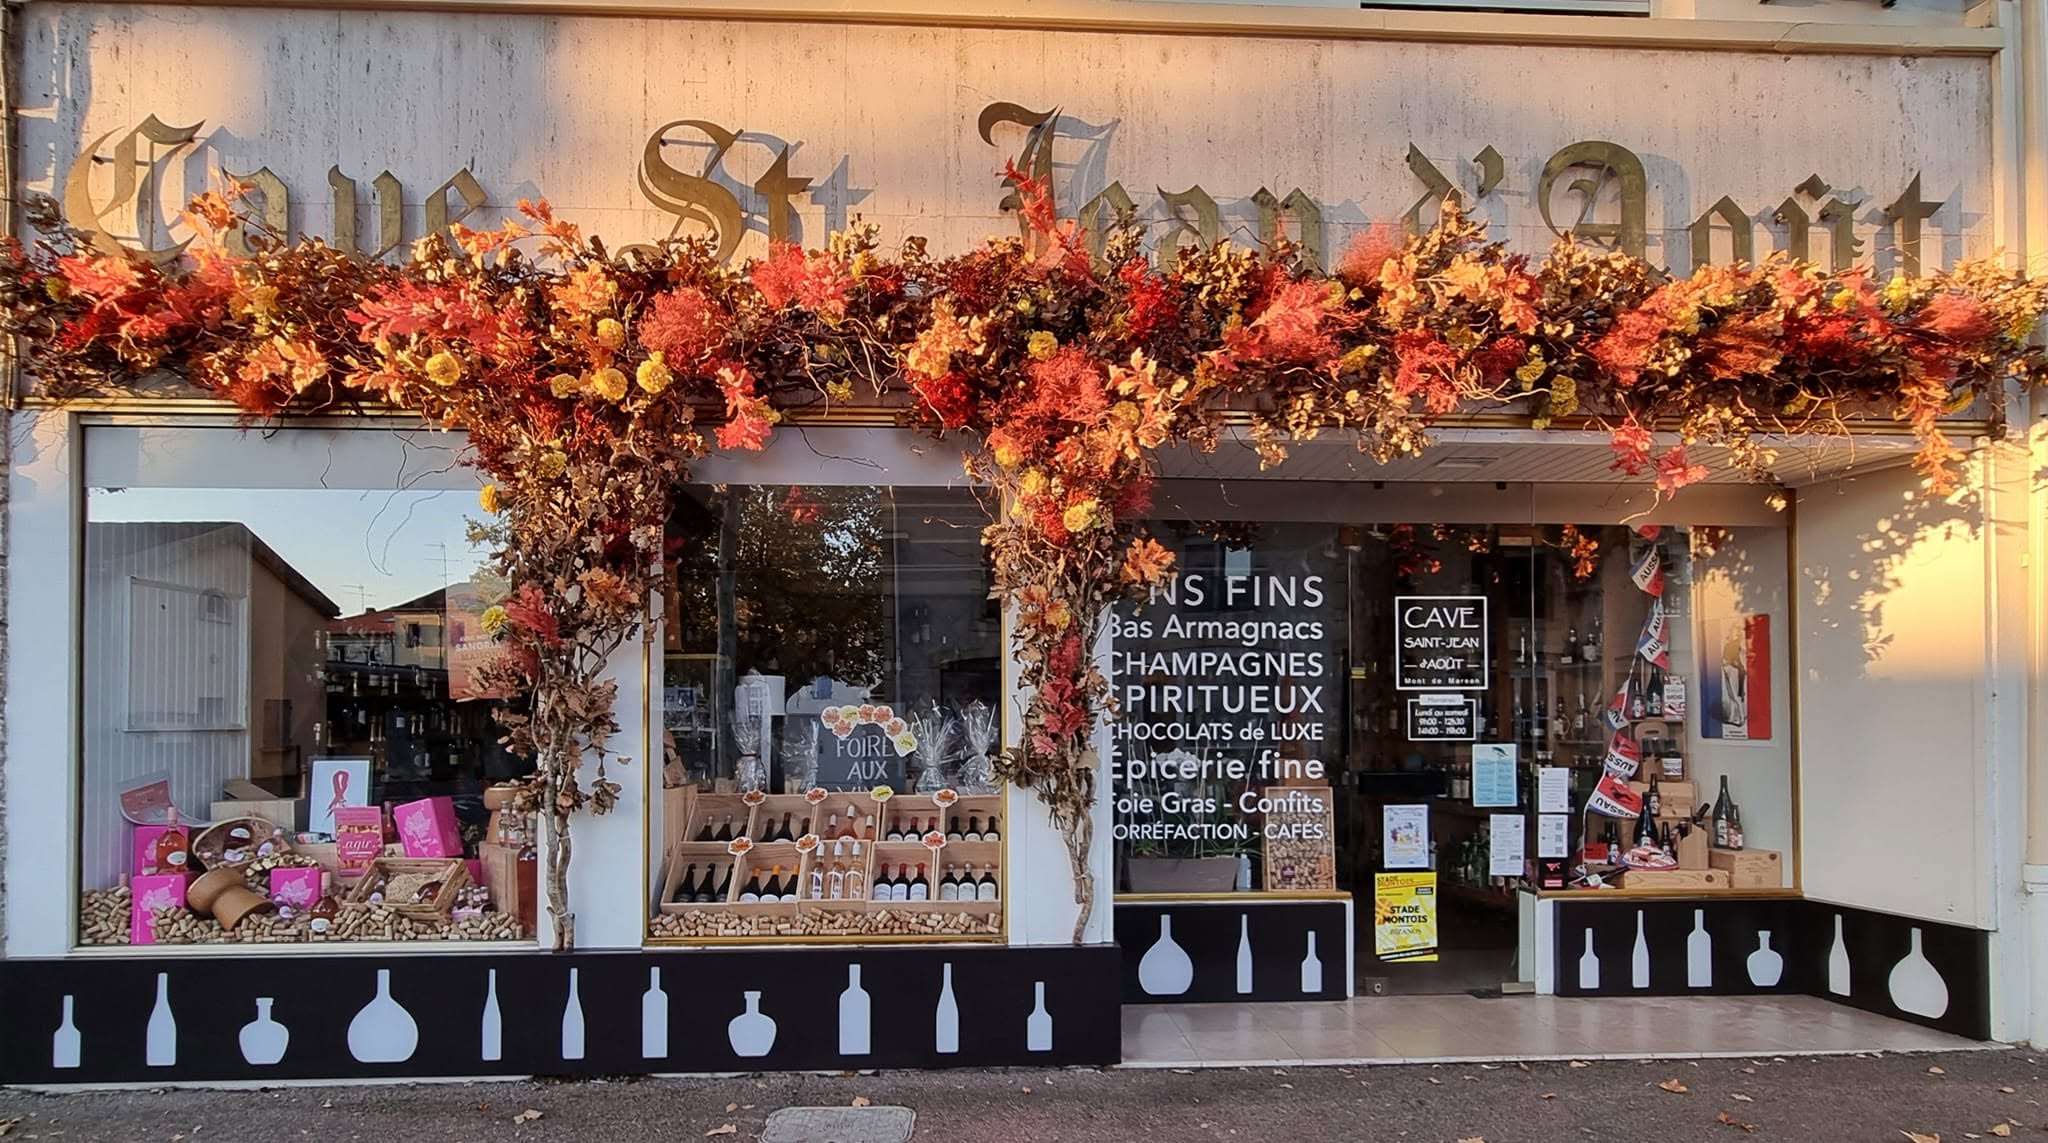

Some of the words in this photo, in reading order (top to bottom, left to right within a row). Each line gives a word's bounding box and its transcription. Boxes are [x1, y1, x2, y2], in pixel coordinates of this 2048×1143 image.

[64, 113, 488, 264] Cave
[615, 119, 814, 264] St
[977, 101, 1321, 277] Jean
[1113, 573, 1205, 607] NS
[1226, 575, 1325, 608] FINS
[1404, 606, 1480, 629] CAVE
[1161, 613, 1324, 647] Armagnacs
[1404, 636, 1480, 649] SAINT-JEAN
[1404, 677, 1426, 685] Mont
[1431, 677, 1442, 685] de
[1239, 721, 1265, 742] de
[1270, 722, 1324, 742] LUXE
[836, 734, 895, 758] FOIRE
[846, 759, 889, 781] AUX
[1258, 749, 1325, 780] fine
[1160, 791, 1217, 815] Gras
[1238, 791, 1324, 815] Confits
[1112, 821, 1248, 840] ORRÉFACTION
[1263, 821, 1324, 840] CAFÉS
[1384, 915, 1429, 924] MONTOIS
[1389, 904, 1421, 914] STADE
